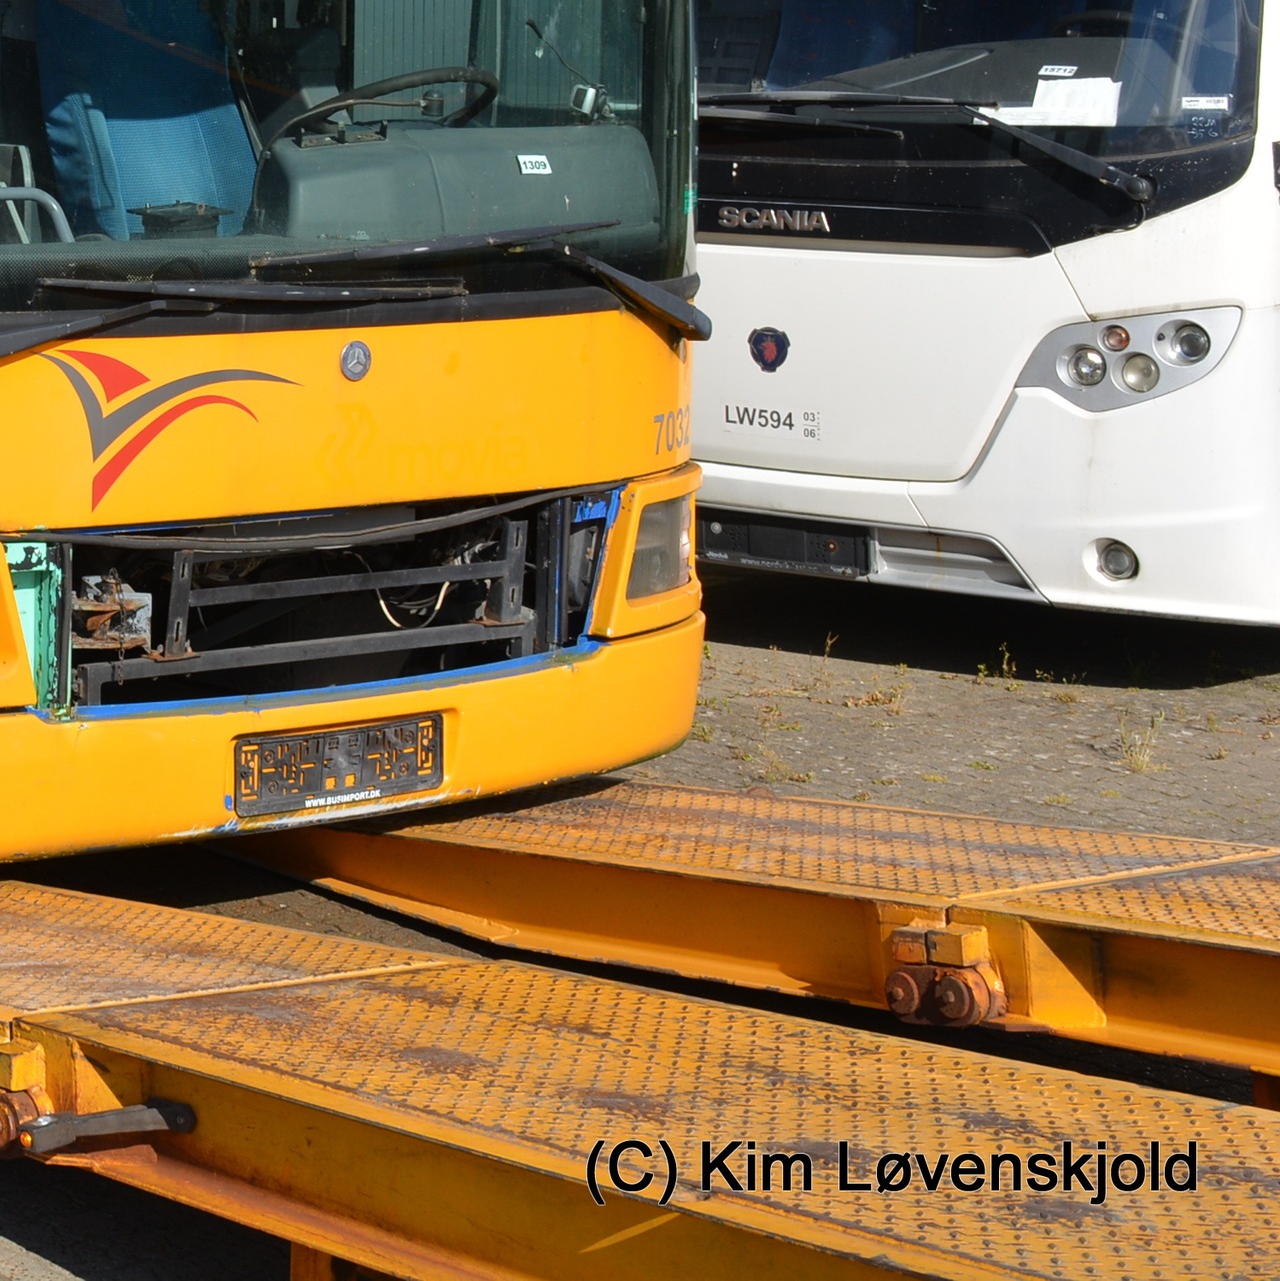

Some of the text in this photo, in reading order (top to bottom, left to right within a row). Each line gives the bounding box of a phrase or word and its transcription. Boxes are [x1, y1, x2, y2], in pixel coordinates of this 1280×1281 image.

[522, 160, 548, 170] 1309
[718, 206, 830, 233] SCANIA
[724, 405, 794, 431] LW594
[803, 411, 816, 422] 03
[803, 428, 816, 438] 06
[305, 789, 381, 808] WWW.BUSIMPORT.DK
